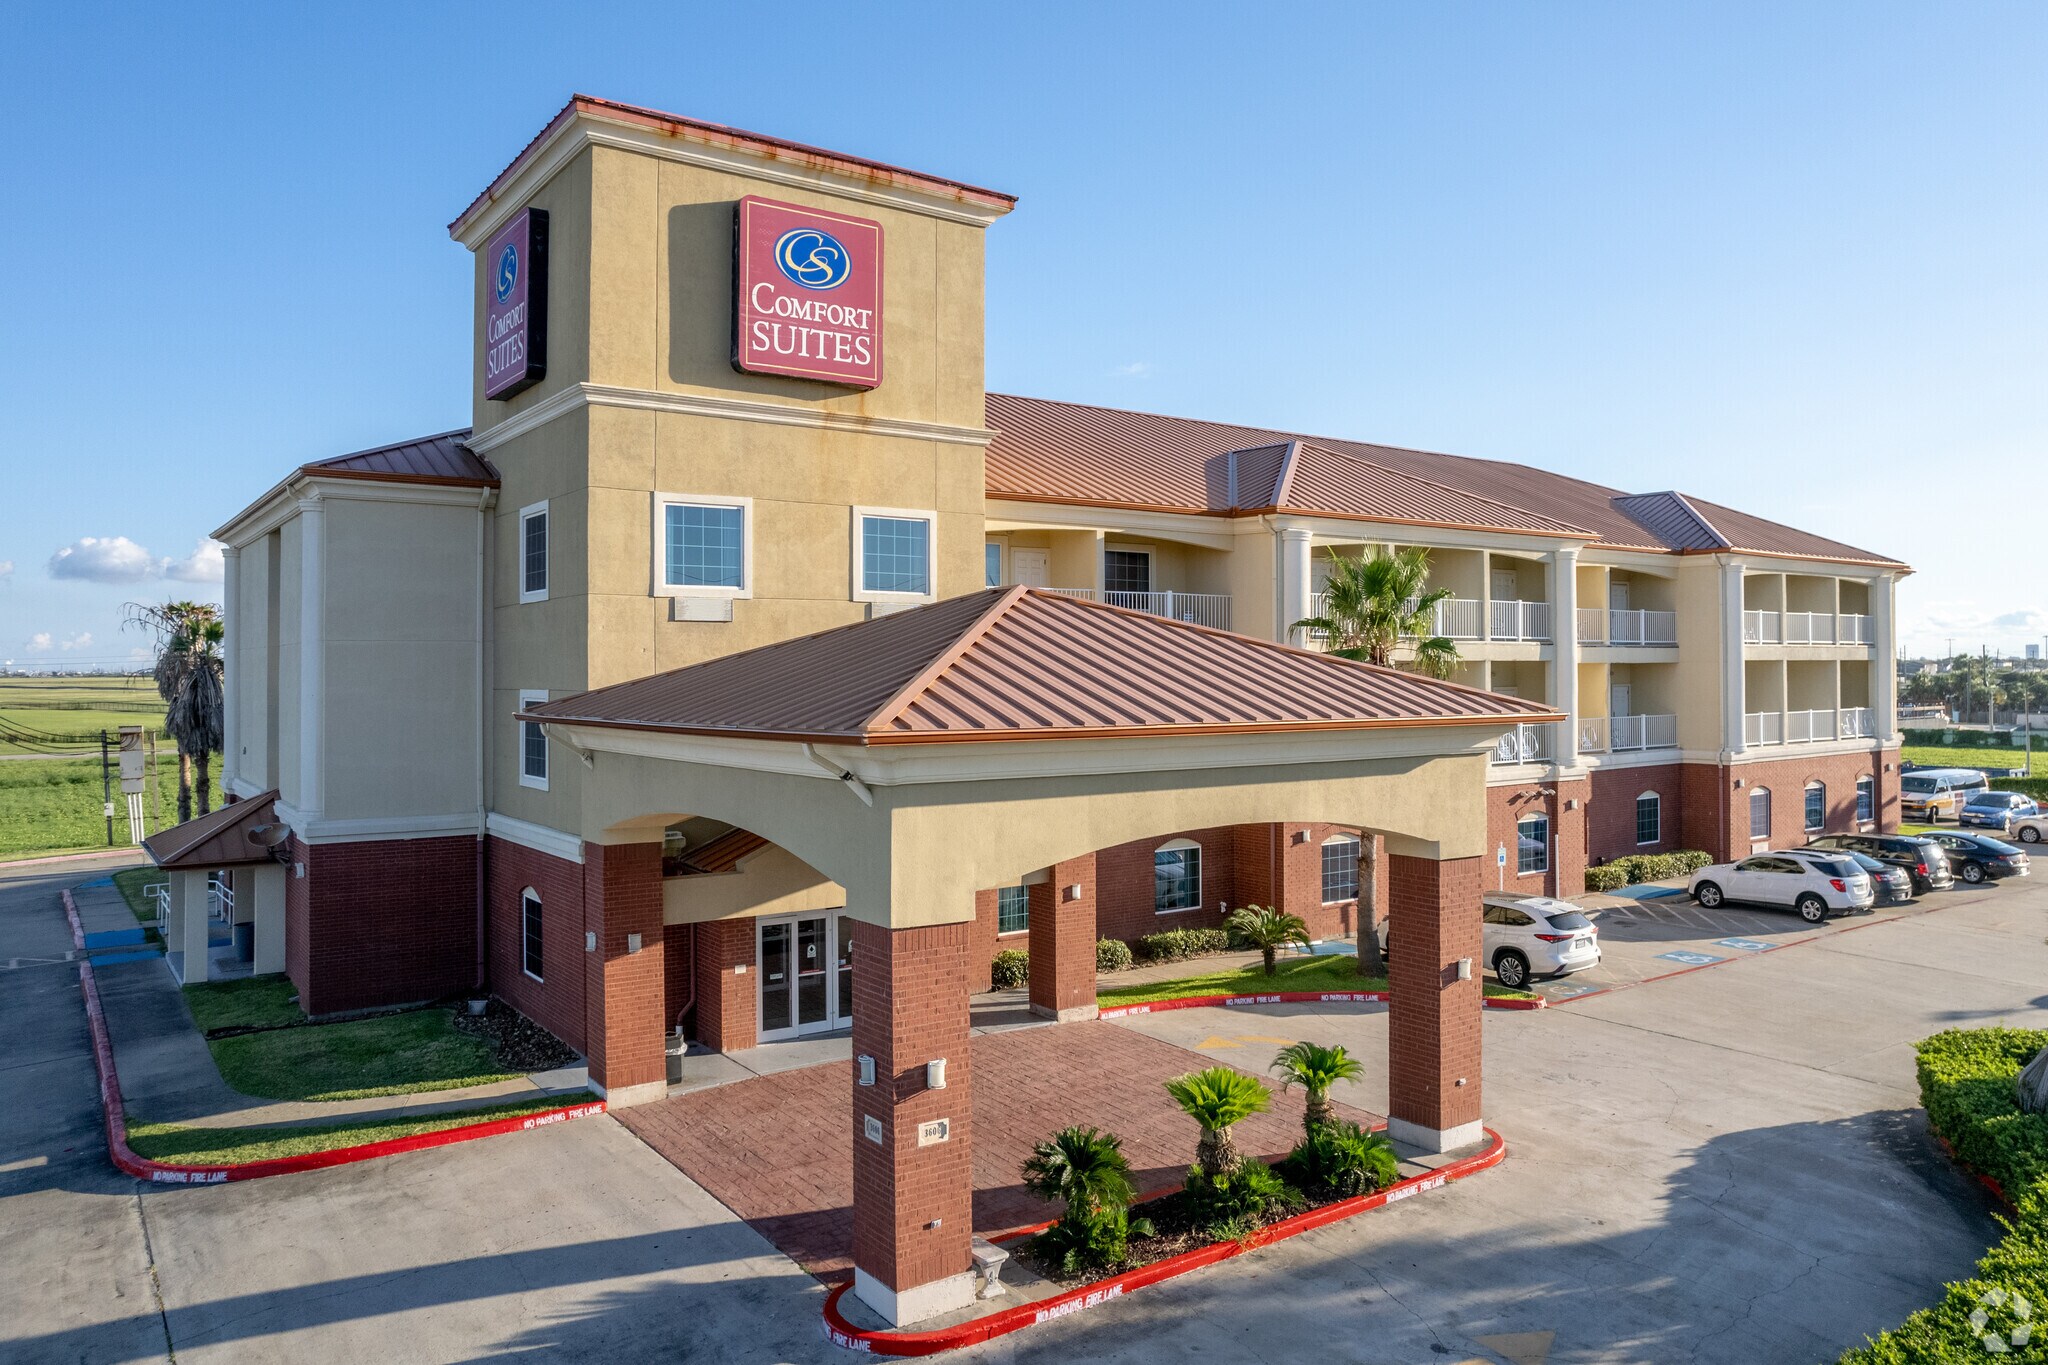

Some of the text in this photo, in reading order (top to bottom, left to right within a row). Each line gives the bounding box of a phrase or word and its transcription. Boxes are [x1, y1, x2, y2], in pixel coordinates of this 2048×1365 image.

[488, 302, 525, 344] COMFORT
[752, 282, 872, 330] COMFORT
[488, 330, 524, 379] SUITES
[752, 320, 871, 365] SUITES
[1226, 998, 1233, 1006] NO
[1234, 997, 1254, 1005] PARKING
[1268, 995, 1281, 1003] LANE
[523, 1104, 602, 1129] NO PARKING FIRE LANE
[153, 1171, 228, 1182] NO PARKING FIRE LANE
[1386, 1175, 1446, 1204] NO PARKING FIRE LANE
[1036, 1283, 1123, 1323] NO PARKING FIRE LANE
[833, 1331, 871, 1352] FIRE LANE
